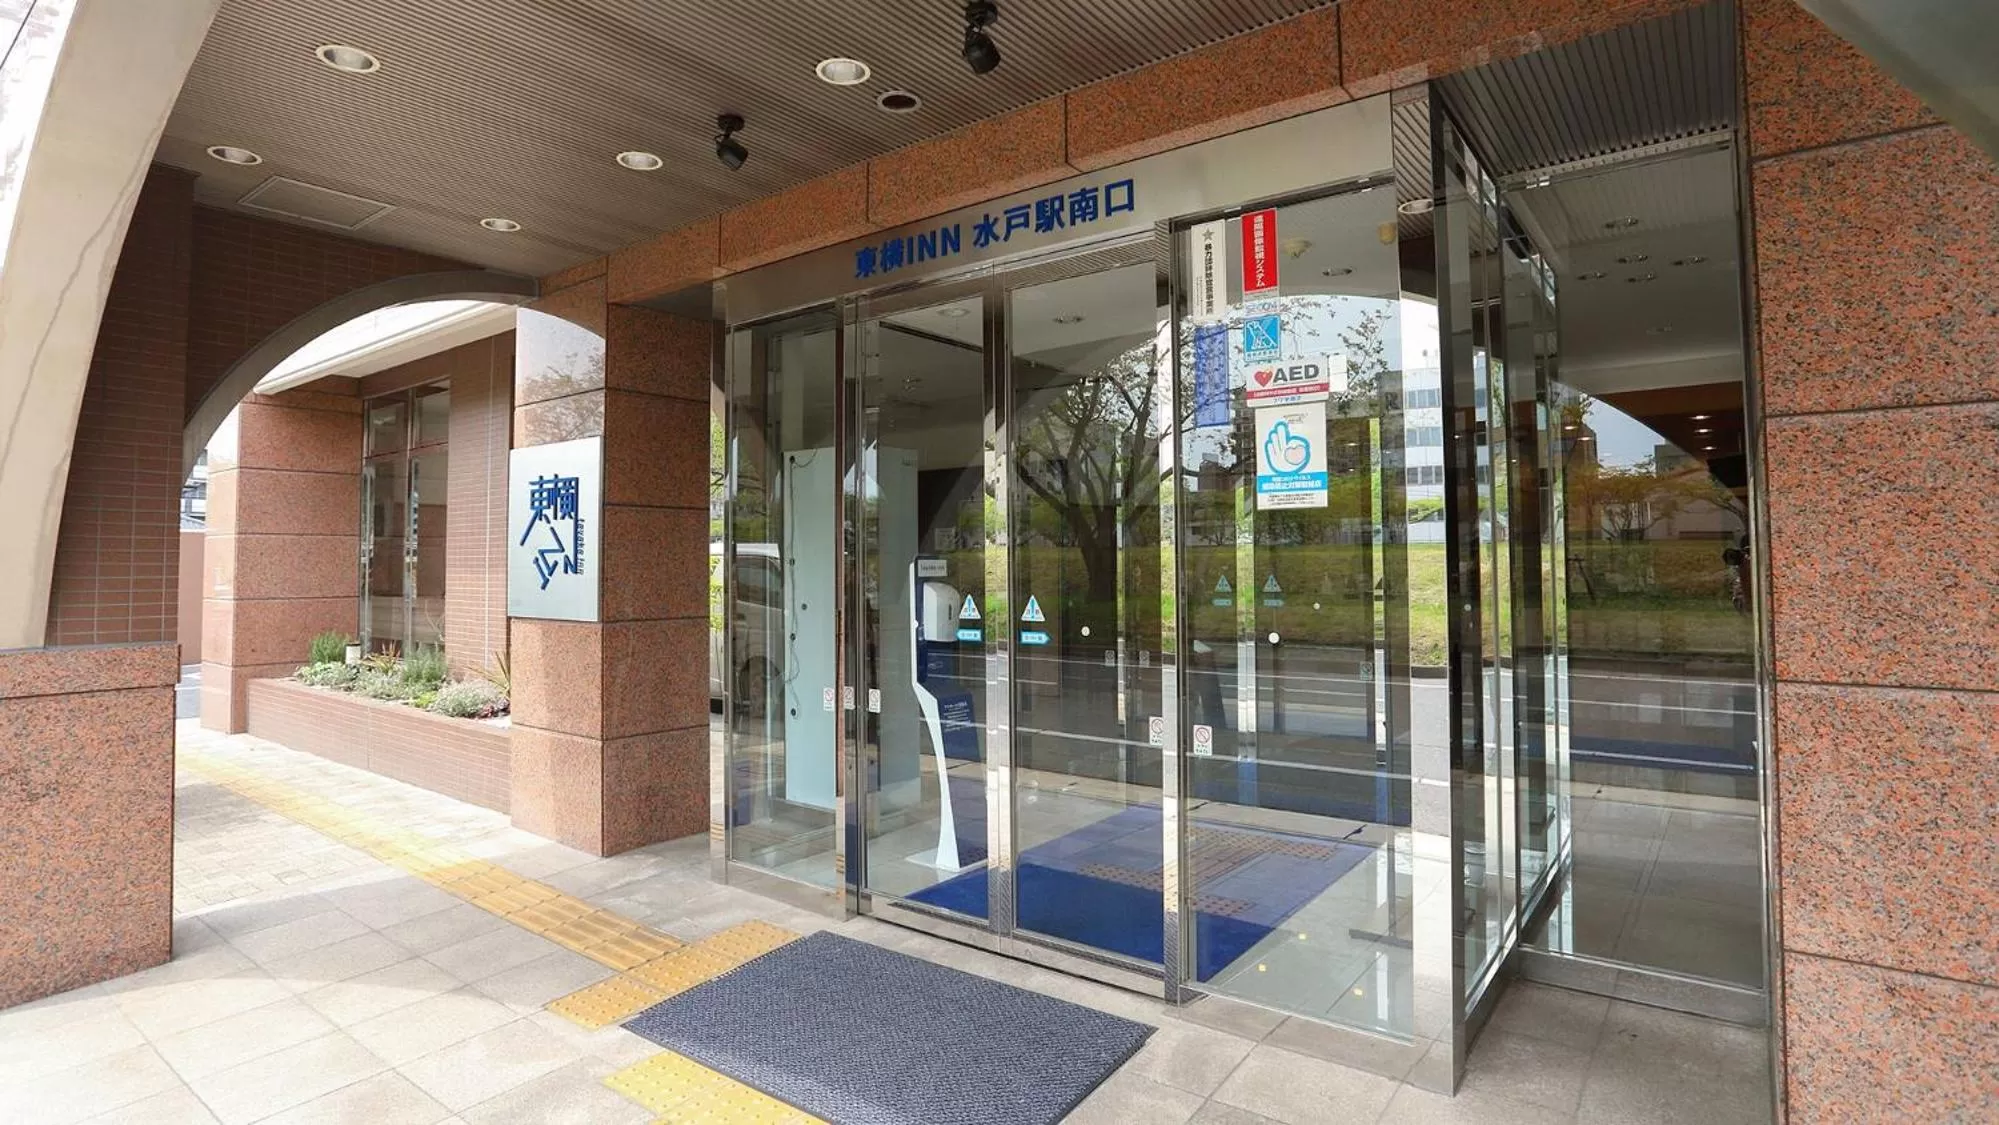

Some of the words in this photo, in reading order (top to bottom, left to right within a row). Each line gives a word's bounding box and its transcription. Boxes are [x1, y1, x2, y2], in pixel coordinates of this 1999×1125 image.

[855, 223, 961, 279] 東横INN
[973, 179, 1136, 248] 水戸駅南口
[1273, 364, 1320, 382] AED
